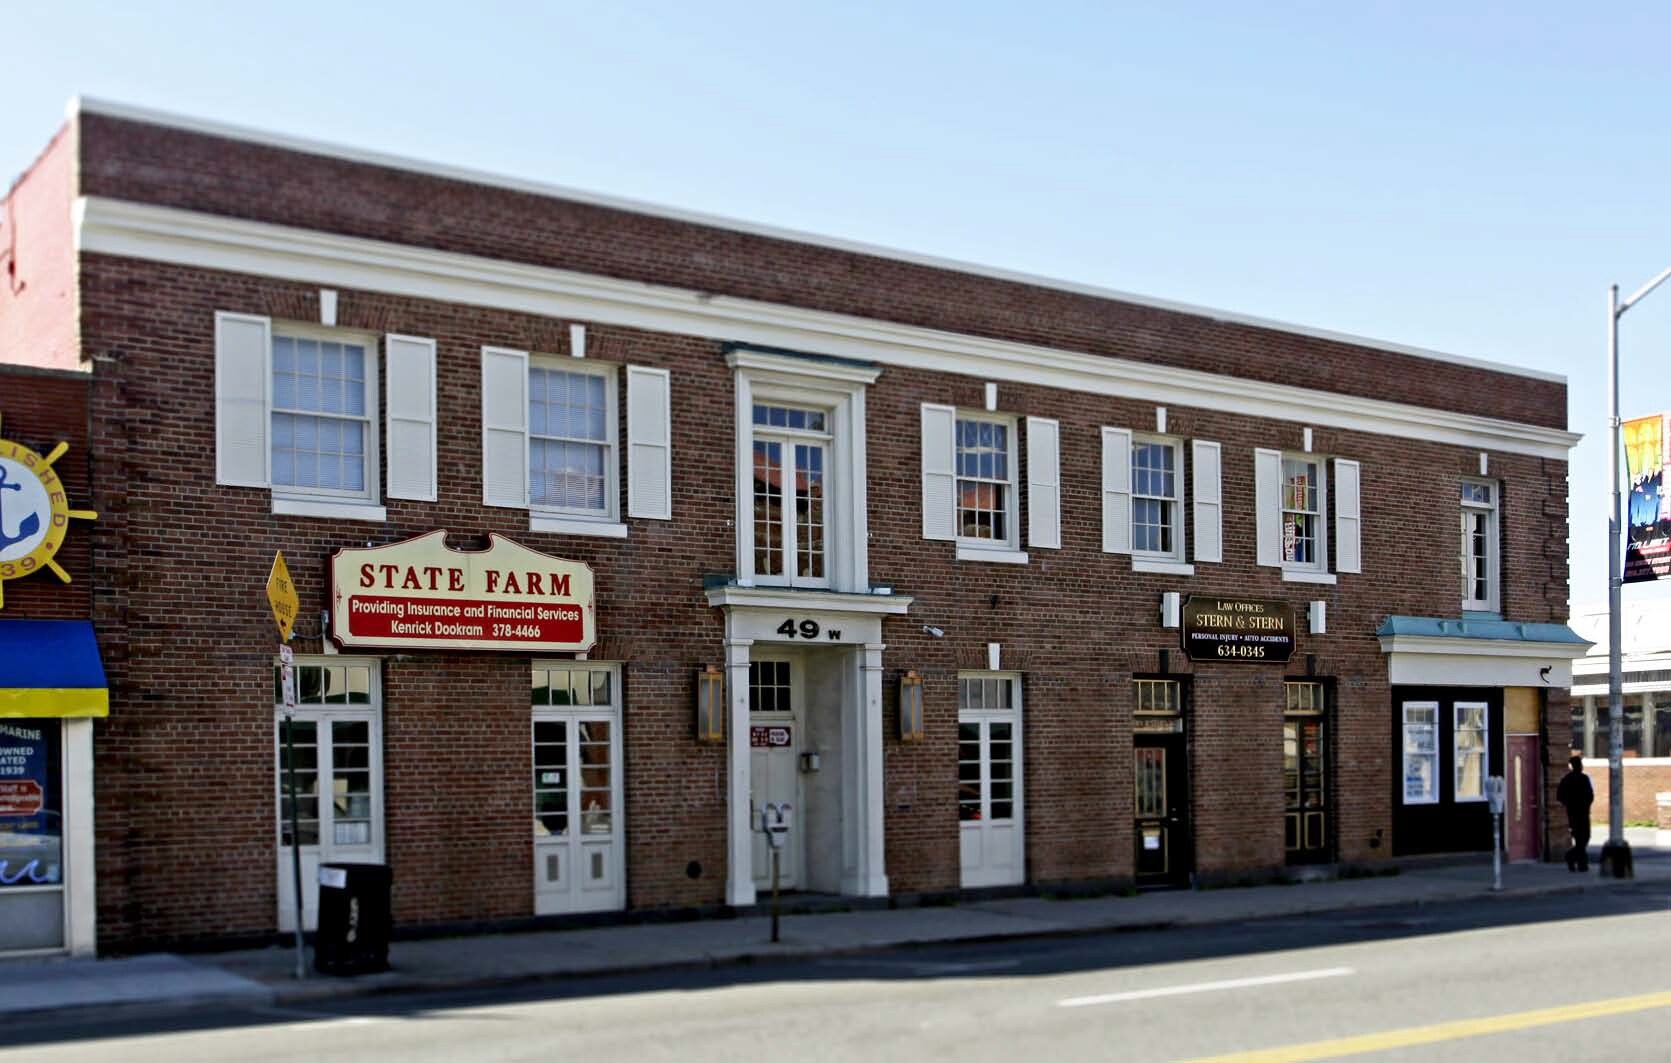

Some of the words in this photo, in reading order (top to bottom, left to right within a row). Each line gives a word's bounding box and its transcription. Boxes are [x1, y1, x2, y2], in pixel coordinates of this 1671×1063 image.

[275, 577, 288, 594] FIRE
[360, 563, 465, 591] STATE
[485, 570, 571, 596] FARM
[275, 600, 292, 618] HOUSE
[352, 600, 404, 617] Providing
[408, 602, 460, 617] Insurance
[464, 604, 485, 618] and
[488, 605, 535, 619] Financial
[537, 607, 580, 621] Services
[391, 620, 432, 635] Kenrick
[435, 622, 483, 637] Dookram
[492, 624, 541, 638] 378-4466
[776, 618, 820, 639] 49
[1196, 614, 1232, 628] STERN
[1235, 616, 1245, 629] &
[1249, 616, 1284, 630] STERN
[1191, 632, 1218, 640] PERSONAL
[1220, 634, 1238, 642] INJURY
[1217, 644, 1265, 658] 634-0345
